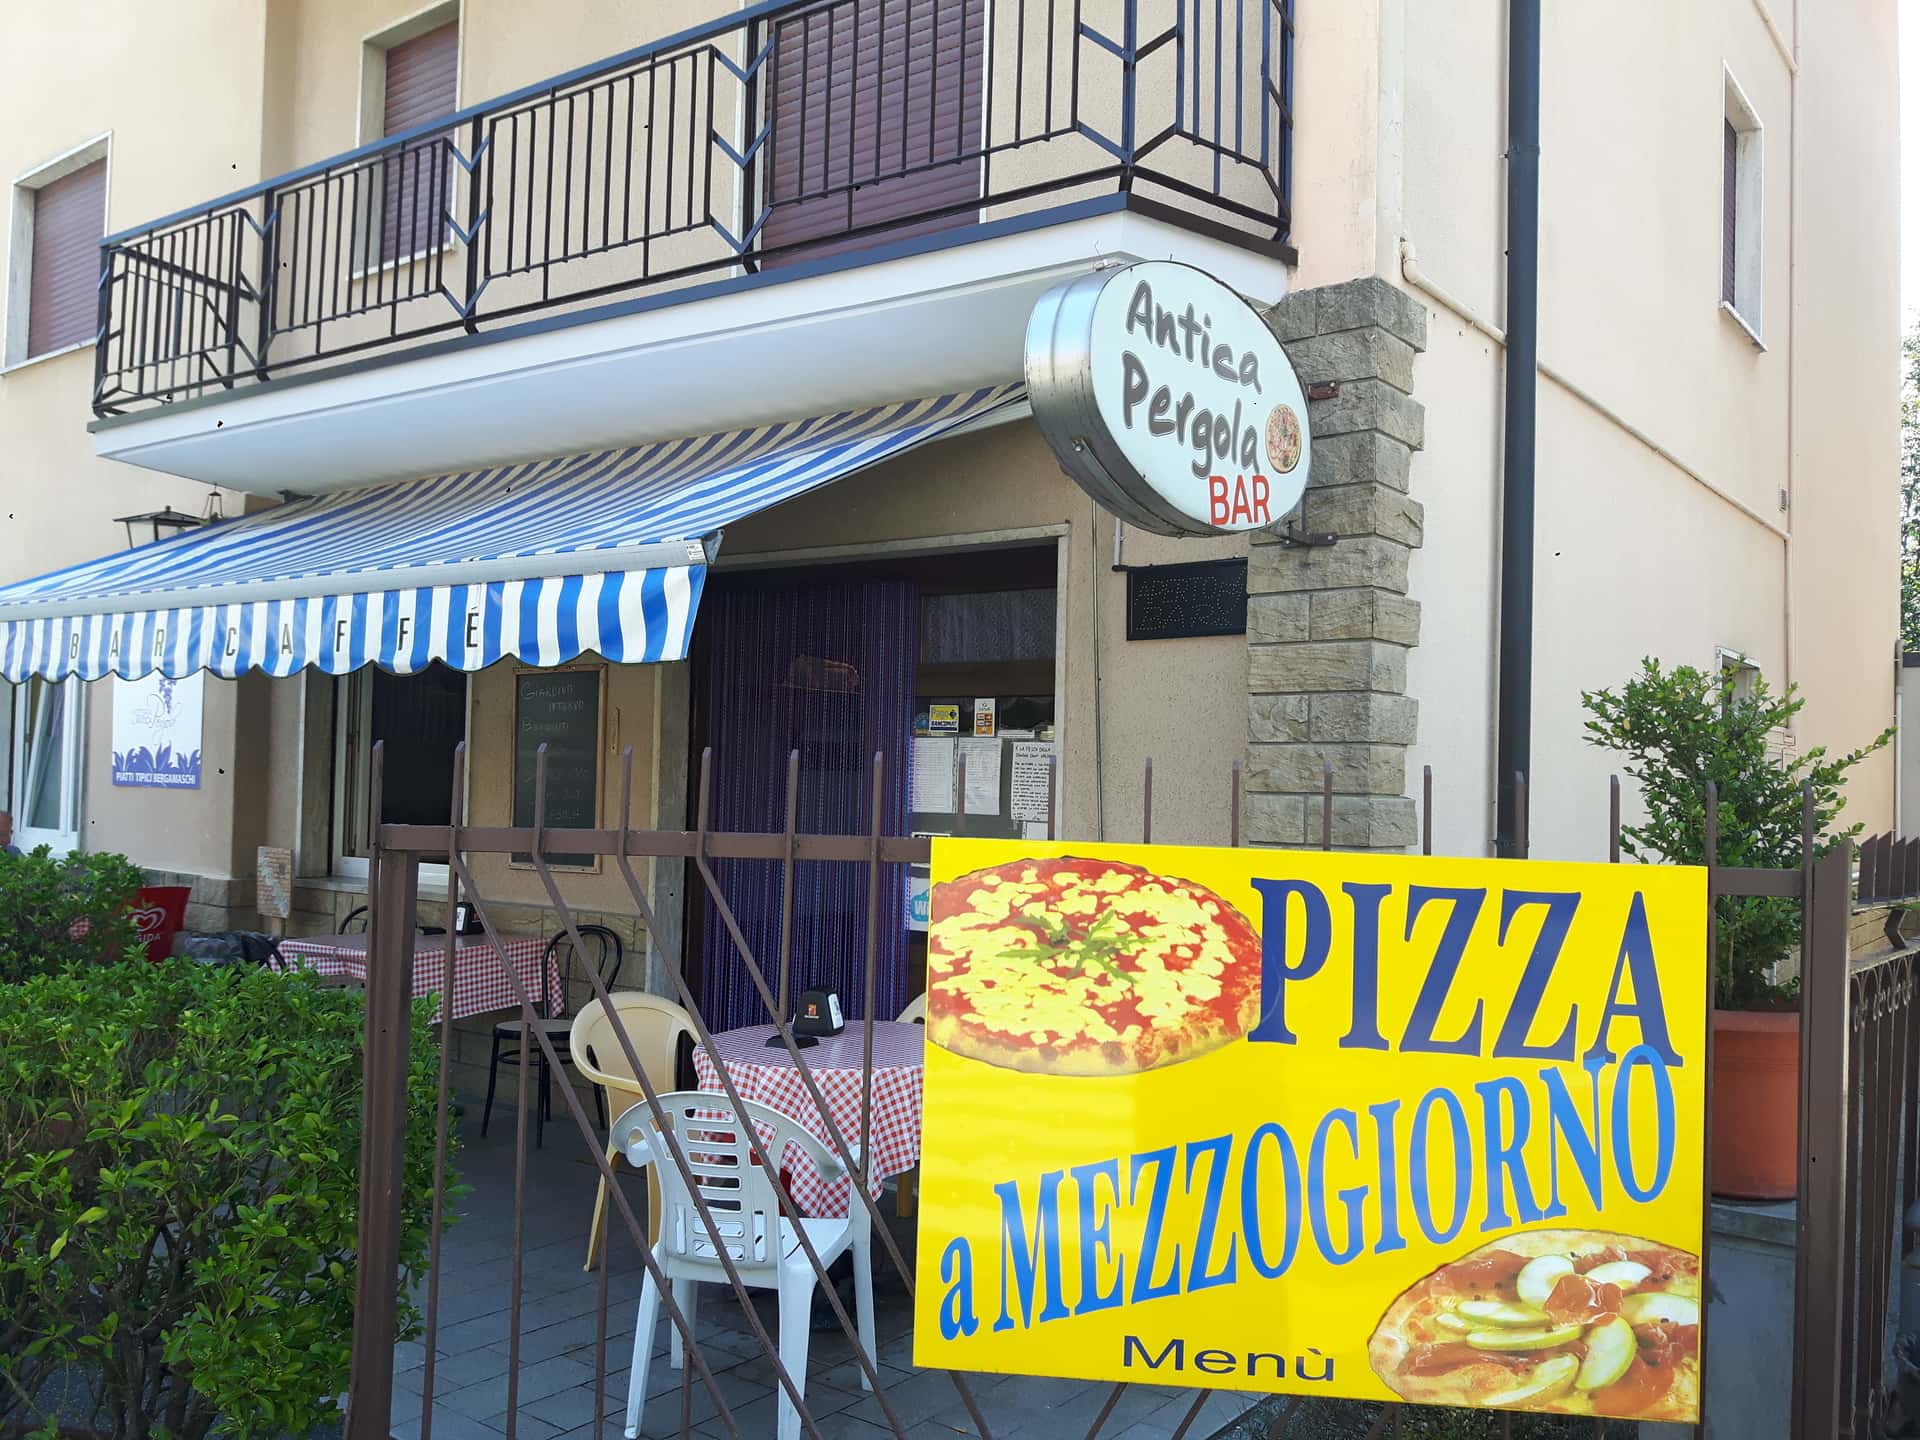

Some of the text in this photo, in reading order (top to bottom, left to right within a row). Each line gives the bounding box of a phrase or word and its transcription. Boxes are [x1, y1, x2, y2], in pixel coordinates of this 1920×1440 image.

[1126, 279, 1263, 395] Antica
[1121, 350, 1260, 480] Pergola
[1208, 474, 1271, 526] BAR
[70, 628, 166, 660] BAR
[115, 772, 134, 782] PIATTI
[135, 772, 152, 782] TIPICI
[1247, 877, 1684, 1067] PIZZA
[939, 1044, 1676, 1341] a MEZZOGIORNO
[1123, 1335, 1335, 1382] Menù
